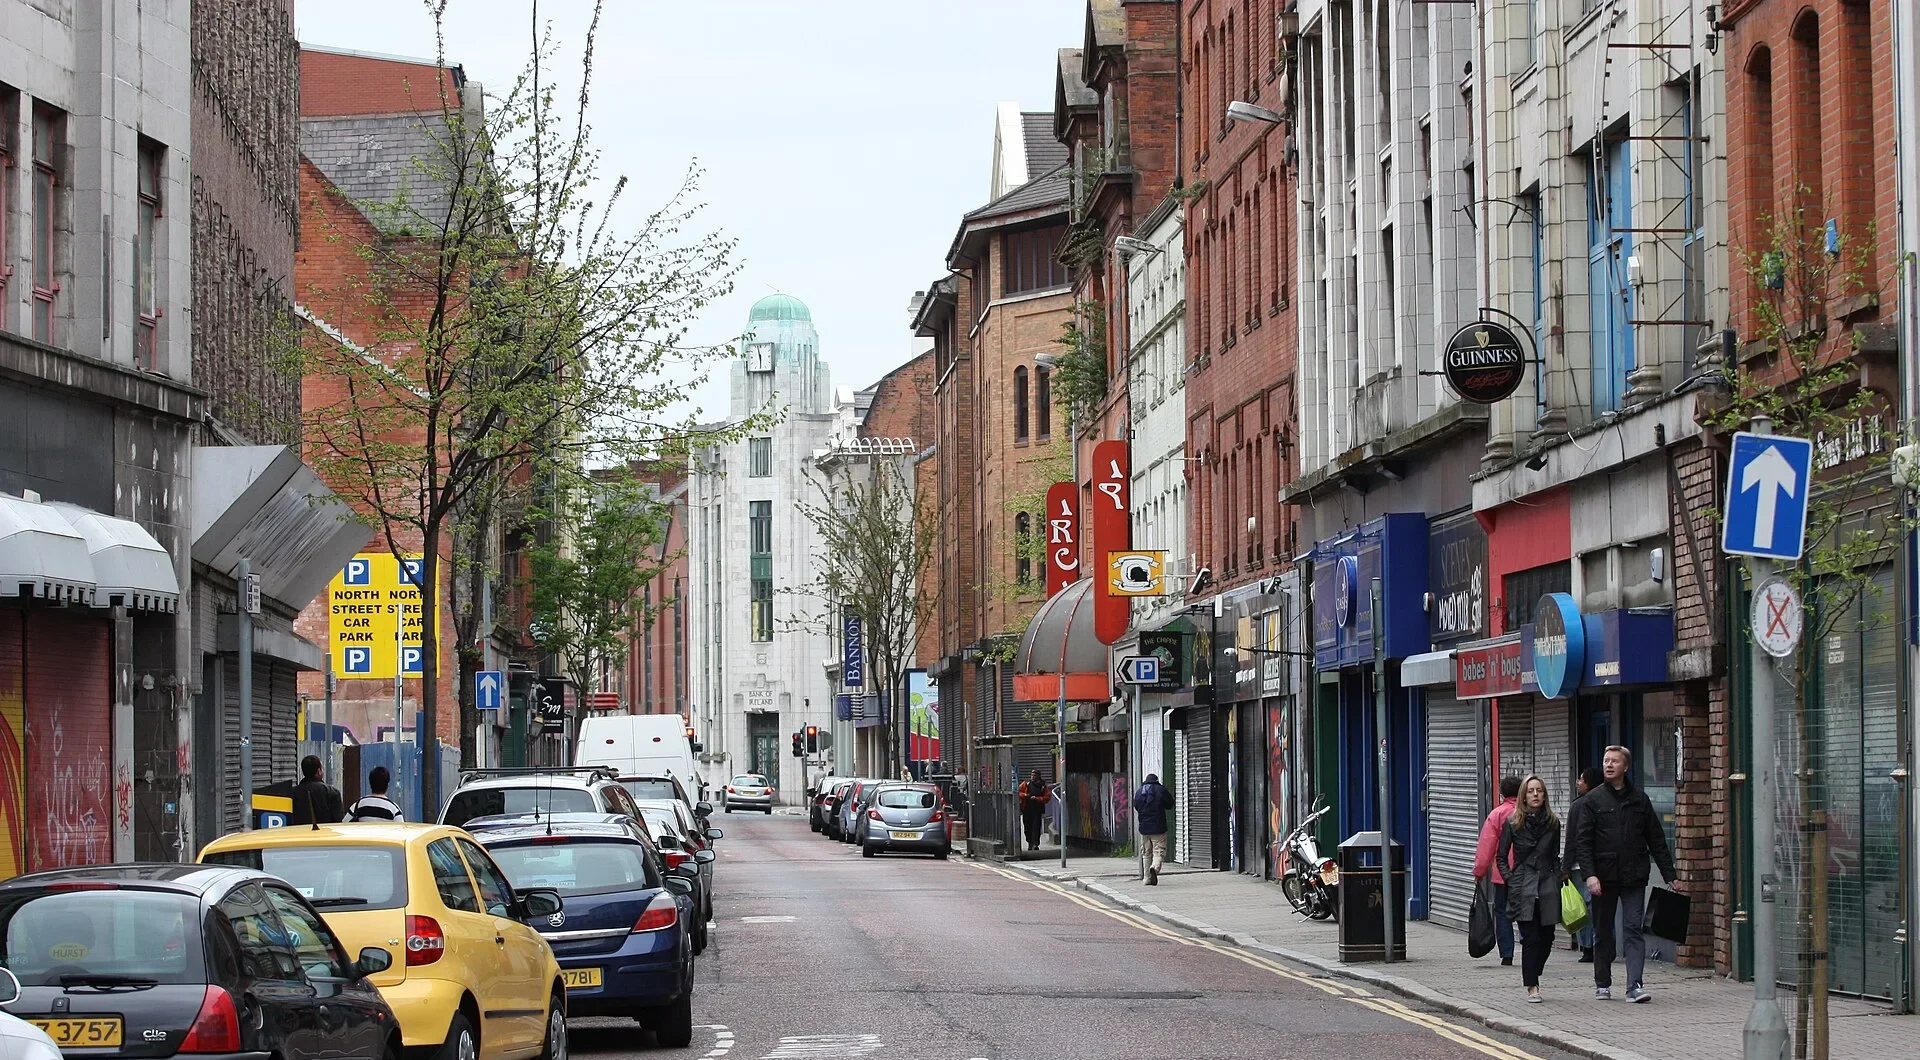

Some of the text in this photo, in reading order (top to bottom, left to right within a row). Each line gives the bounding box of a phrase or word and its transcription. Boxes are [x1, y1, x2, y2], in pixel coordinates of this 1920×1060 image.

[1450, 348, 1518, 367] GUINNESS
[348, 561, 365, 583] P
[1440, 537, 1472, 589] SCENES
[334, 590, 380, 600] NORTH
[389, 590, 423, 600] NORT
[332, 604, 382, 614] STREET
[343, 618, 370, 627] CAR
[339, 632, 374, 641] PARK
[395, 632, 423, 641] AR
[1144, 638, 1155, 646] THE
[847, 614, 860, 681] BANNON
[349, 649, 366, 671] P
[403, 649, 420, 670] P
[1462, 657, 1486, 682] babes
[1488, 654, 1499, 677] 'n'
[1501, 651, 1521, 681] boys
[1140, 661, 1153, 679] P
[52, 949, 84, 958] HURST
[57, 1021, 118, 1042] 3757
